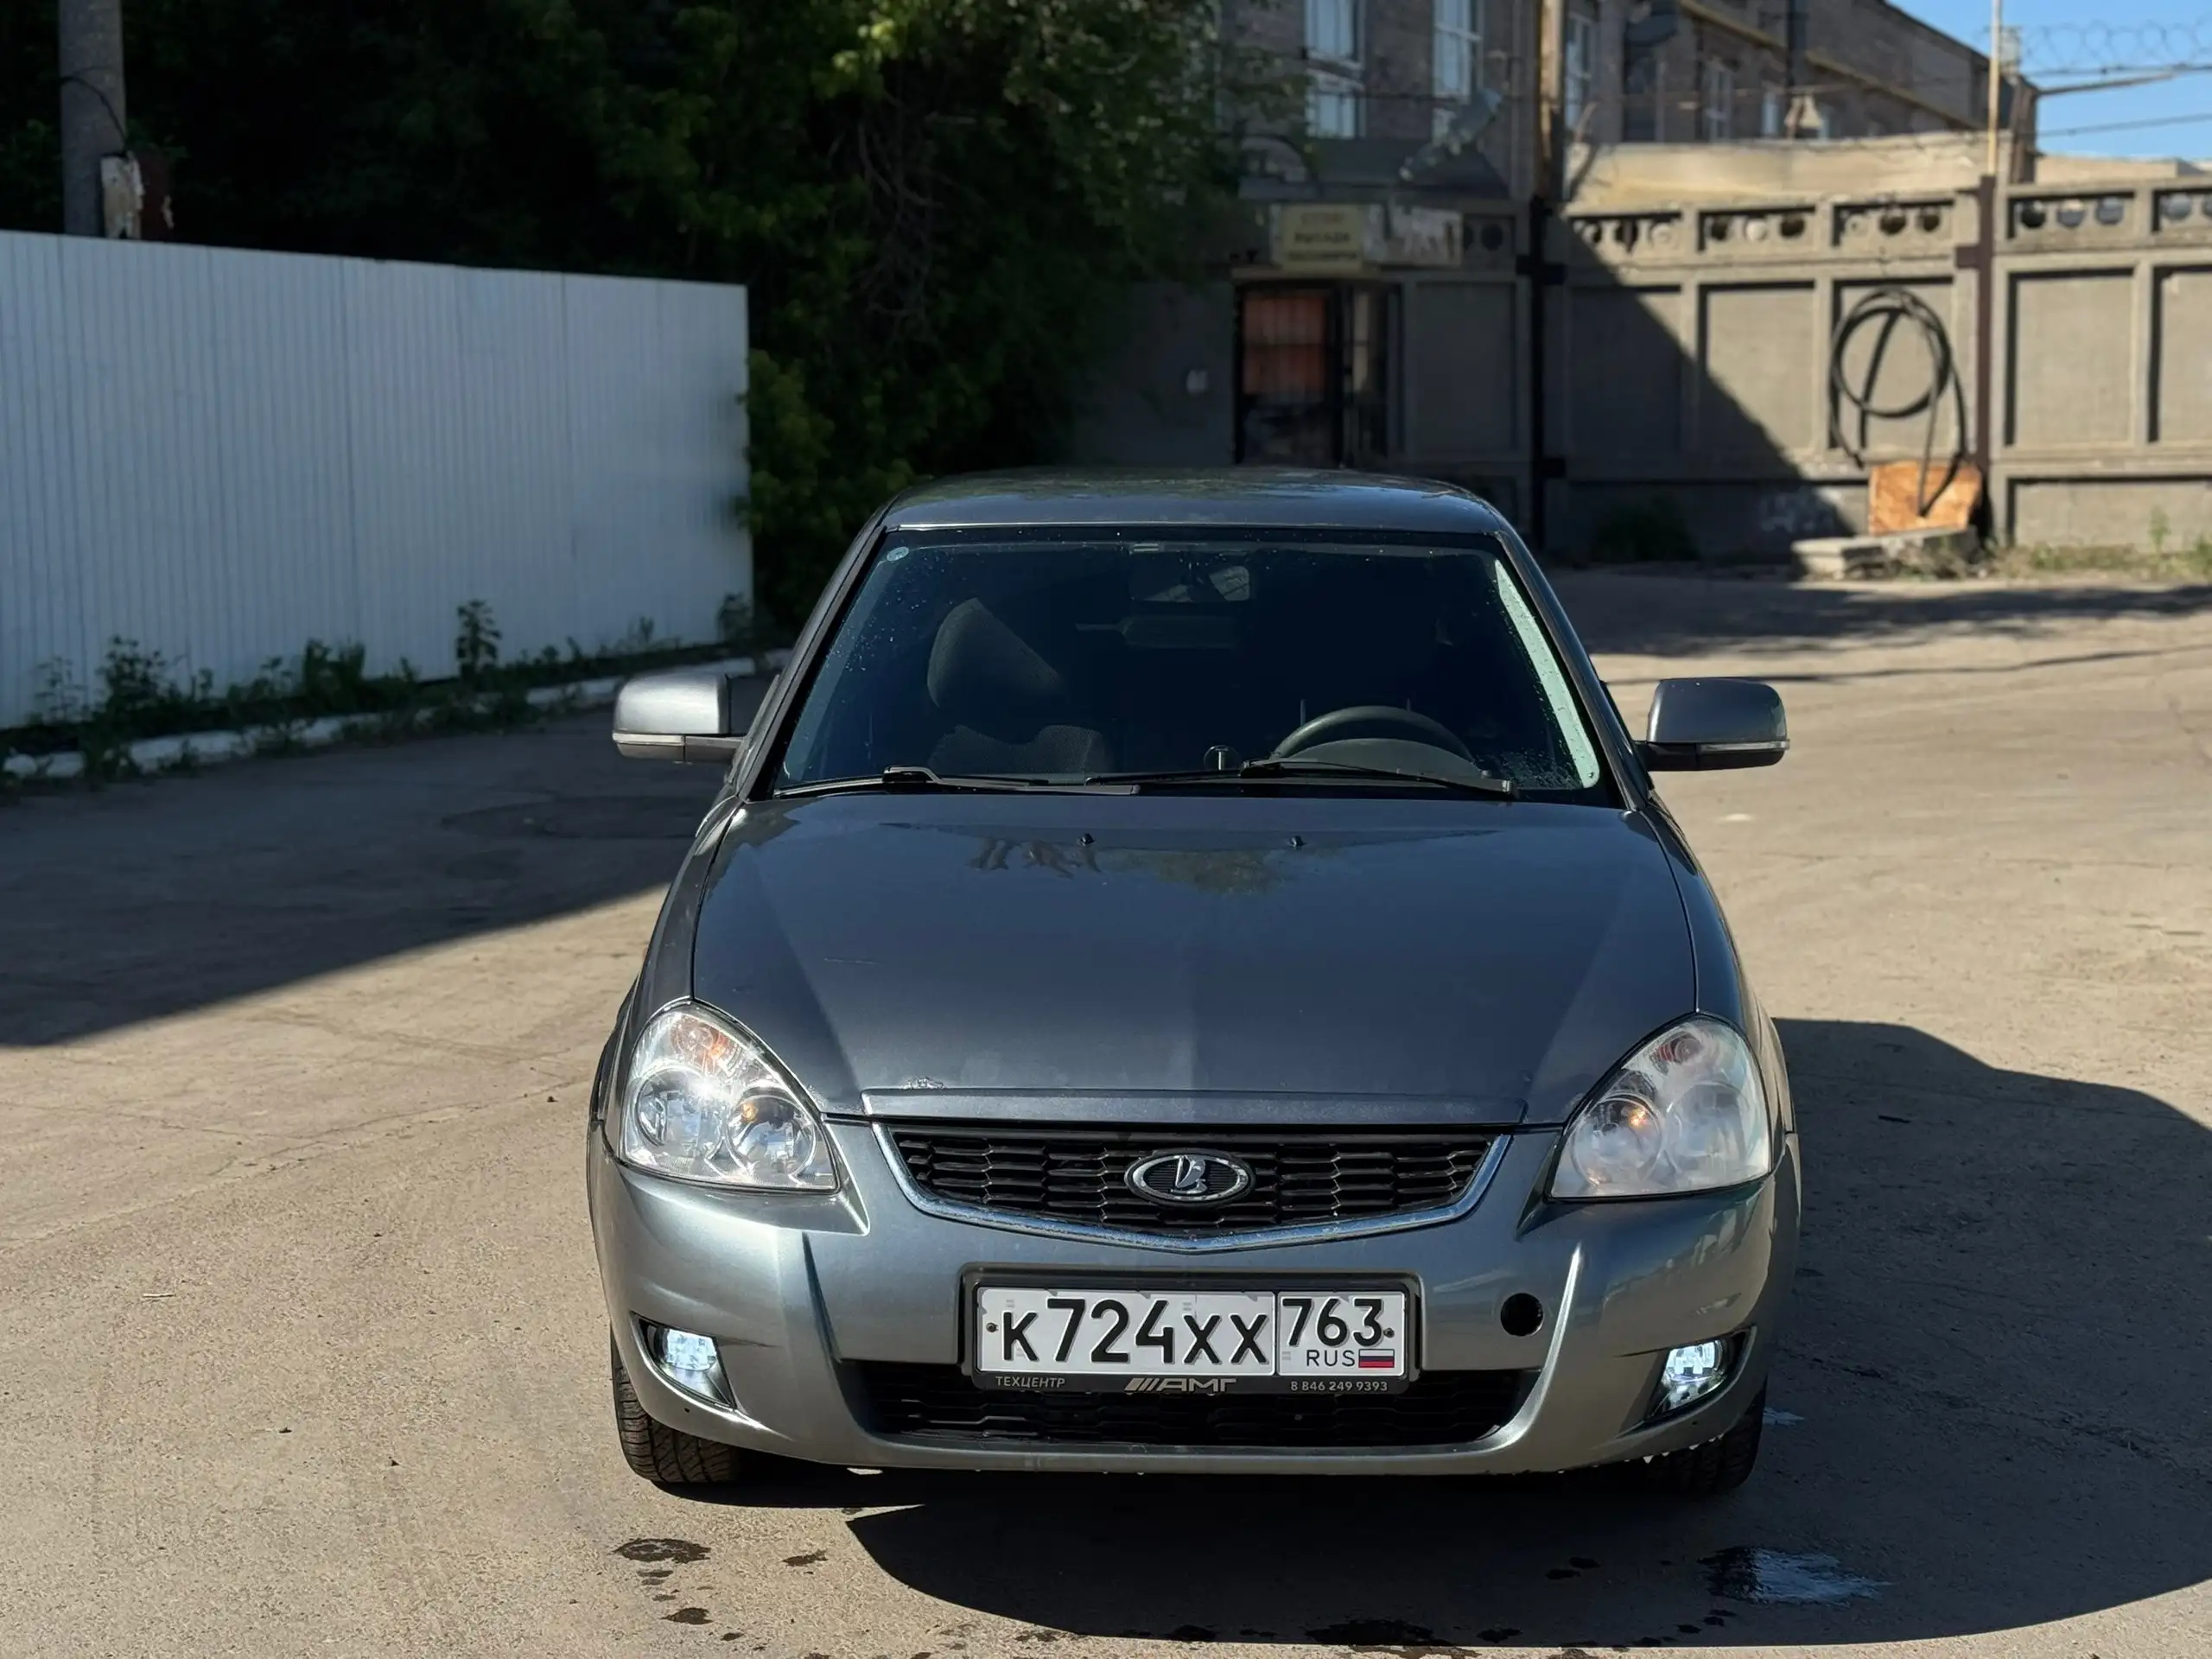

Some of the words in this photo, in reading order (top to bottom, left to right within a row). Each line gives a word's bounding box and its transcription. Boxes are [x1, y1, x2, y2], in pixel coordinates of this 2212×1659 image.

[1281, 1298, 1383, 1347] 763
[1306, 1349, 1356, 1367] RUS
[995, 1376, 1065, 1389] ТЕХЦЕНТР
[1290, 1381, 1299, 1391] 8
[1301, 1381, 1326, 1391] 846
[1329, 1381, 1353, 1391] 249
[1356, 1381, 1388, 1391] 9393
